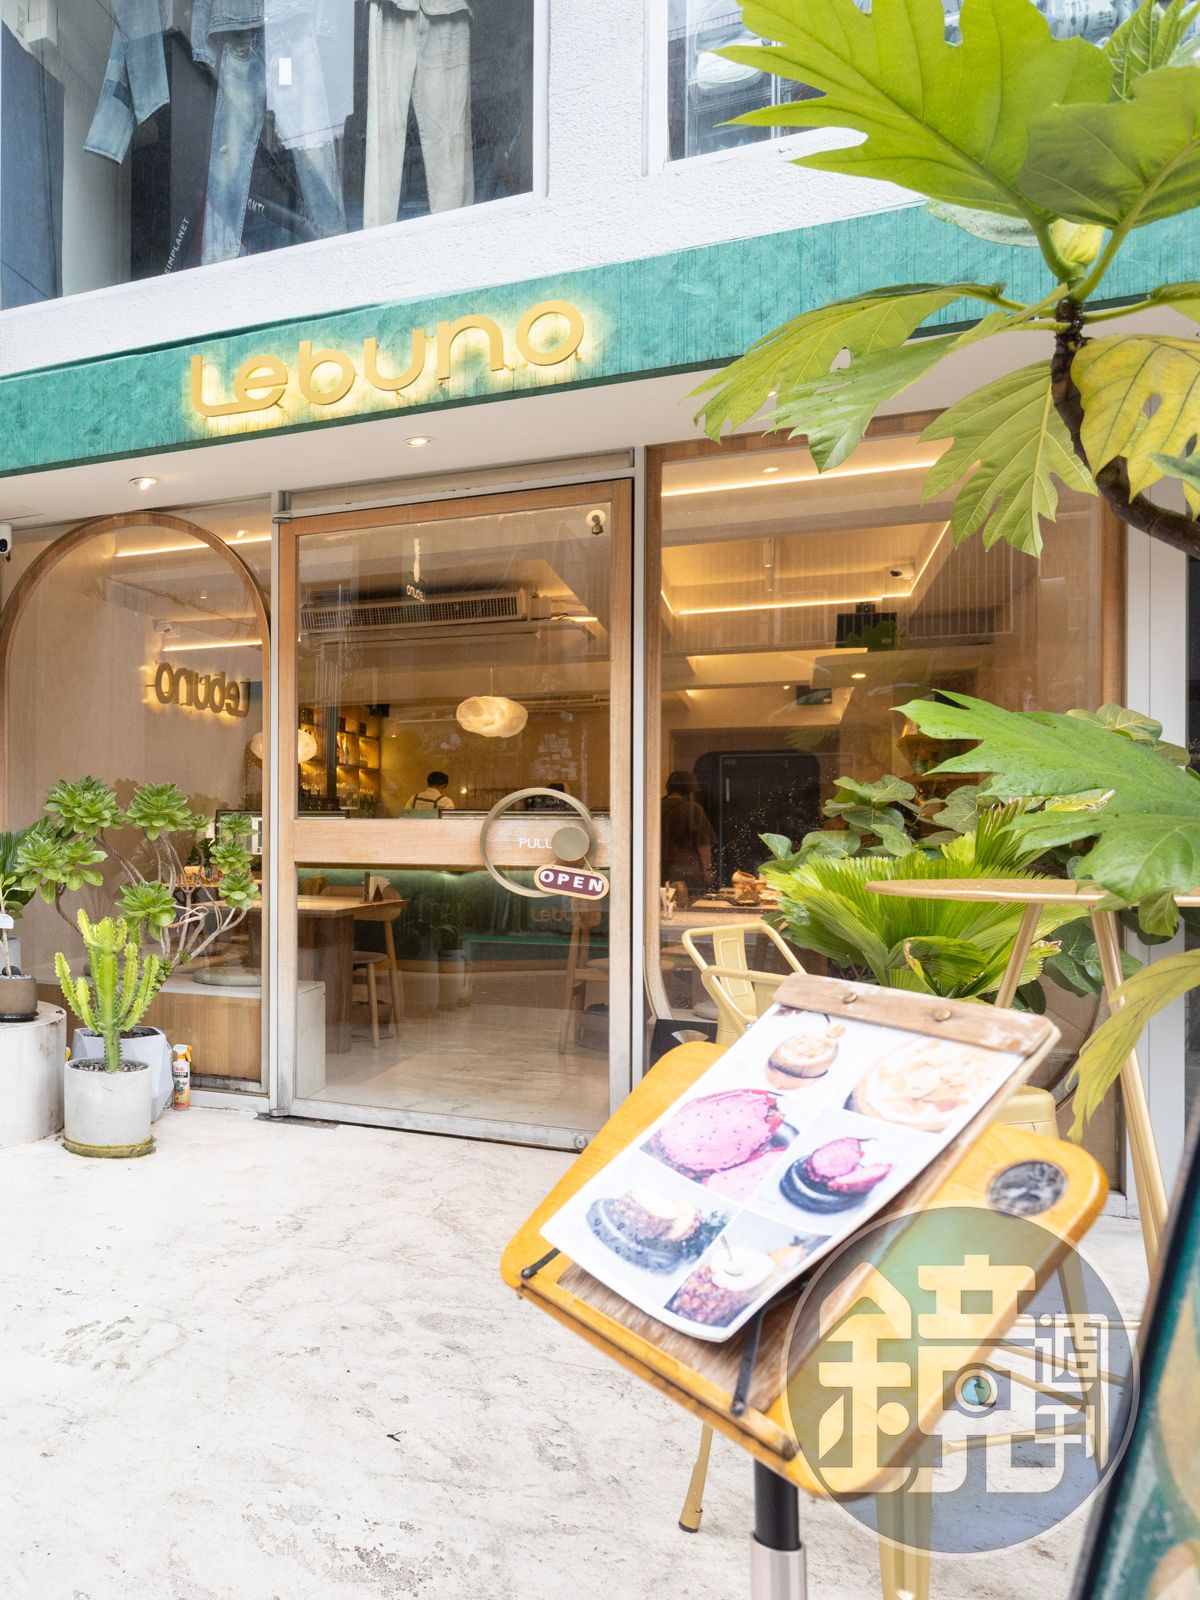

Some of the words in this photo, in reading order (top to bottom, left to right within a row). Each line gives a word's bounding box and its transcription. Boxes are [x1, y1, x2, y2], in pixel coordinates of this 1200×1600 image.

[190, 299, 585, 417] Lebuno
[519, 837, 552, 849] PULL
[539, 870, 604, 892] OPEN
